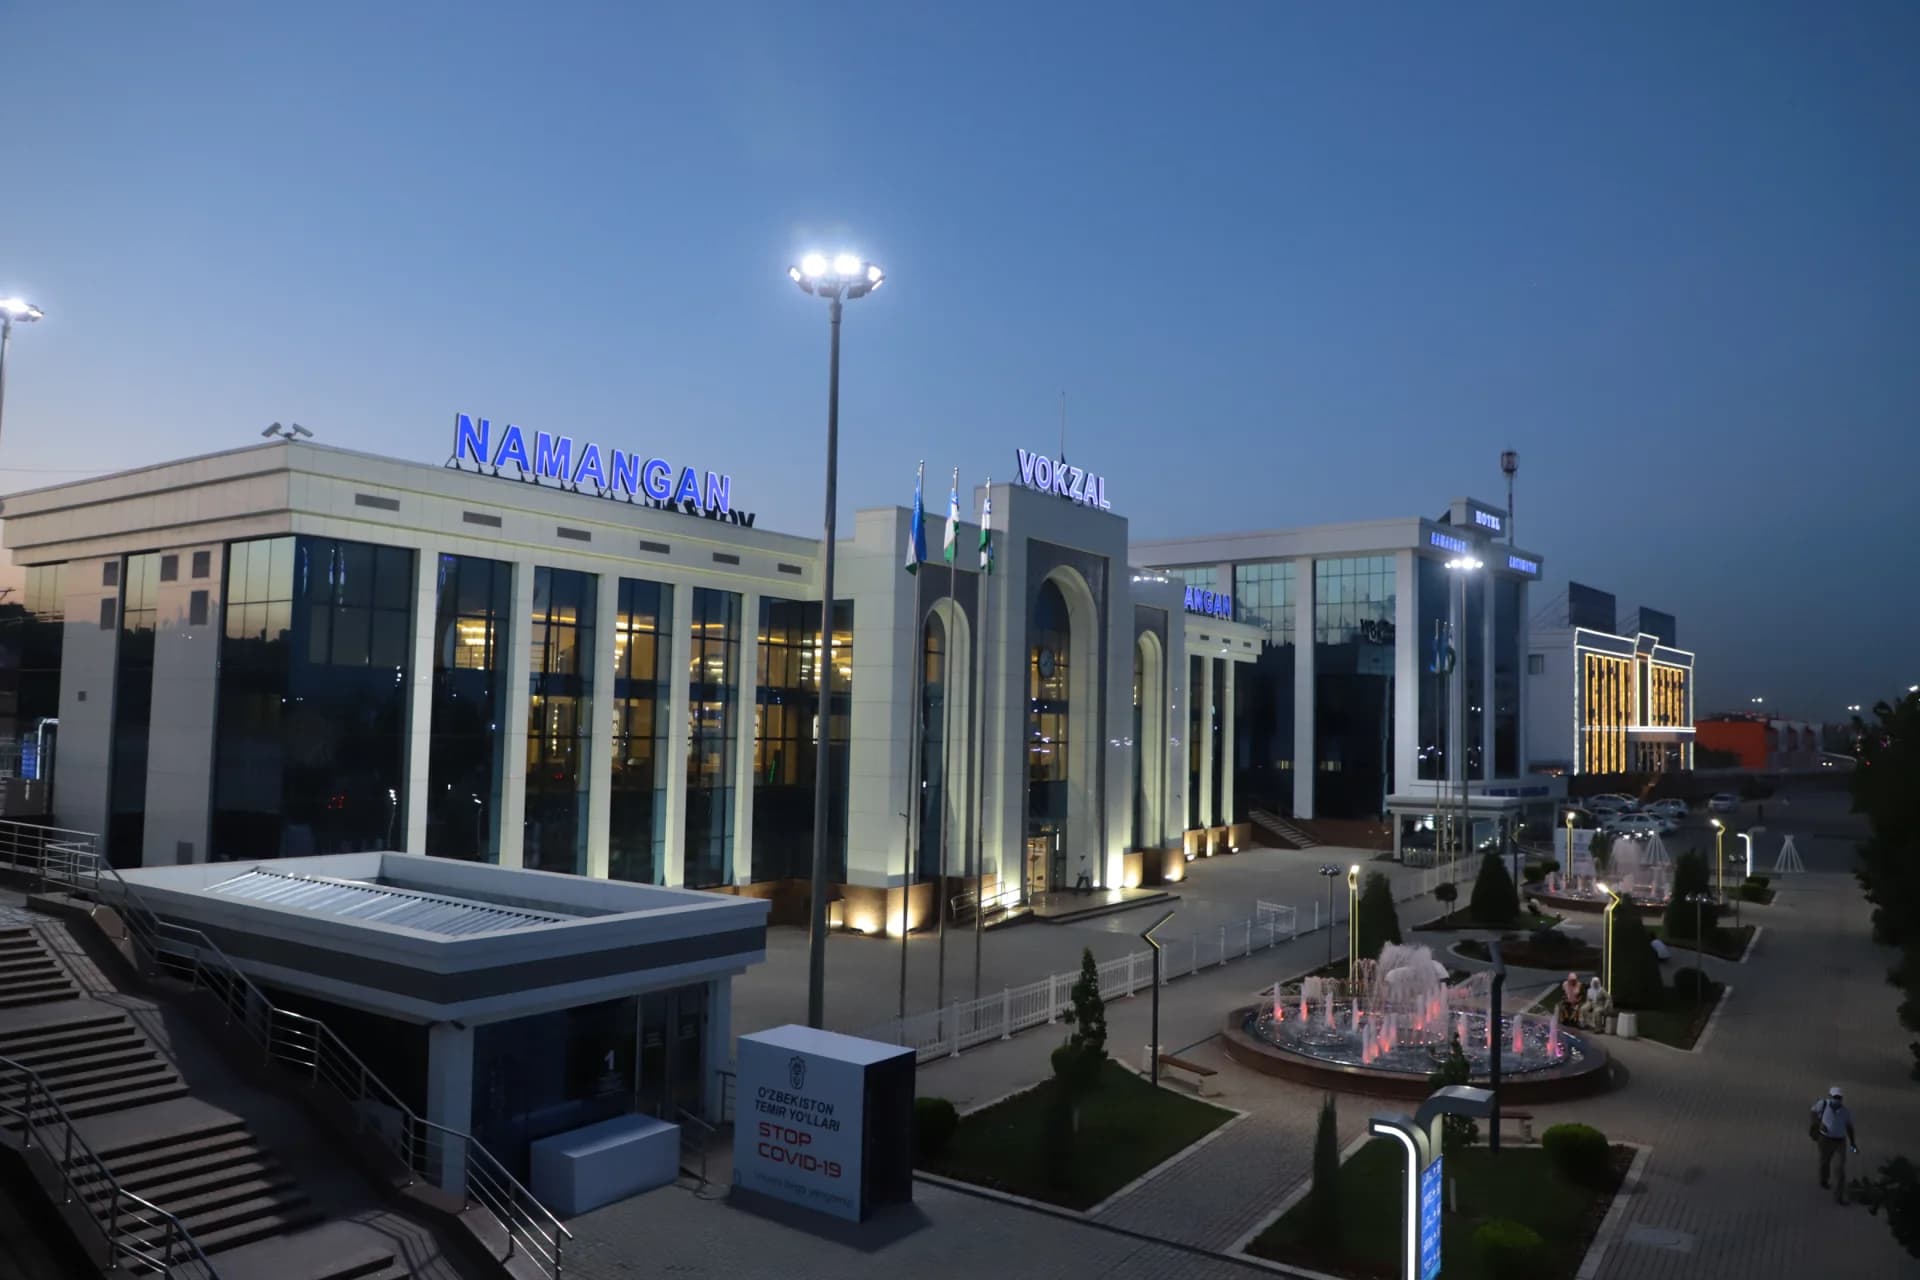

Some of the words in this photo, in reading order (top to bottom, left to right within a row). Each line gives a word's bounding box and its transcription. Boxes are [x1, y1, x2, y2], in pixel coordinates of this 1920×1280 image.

[455, 412, 732, 514] NAMANGAN
[1017, 448, 1111, 509] VOKZAL
[1475, 509, 1501, 531] HOTEL
[755, 1100, 786, 1119] TEMIR
[758, 1121, 812, 1146] STOP
[758, 1142, 842, 1178] COVID-19
